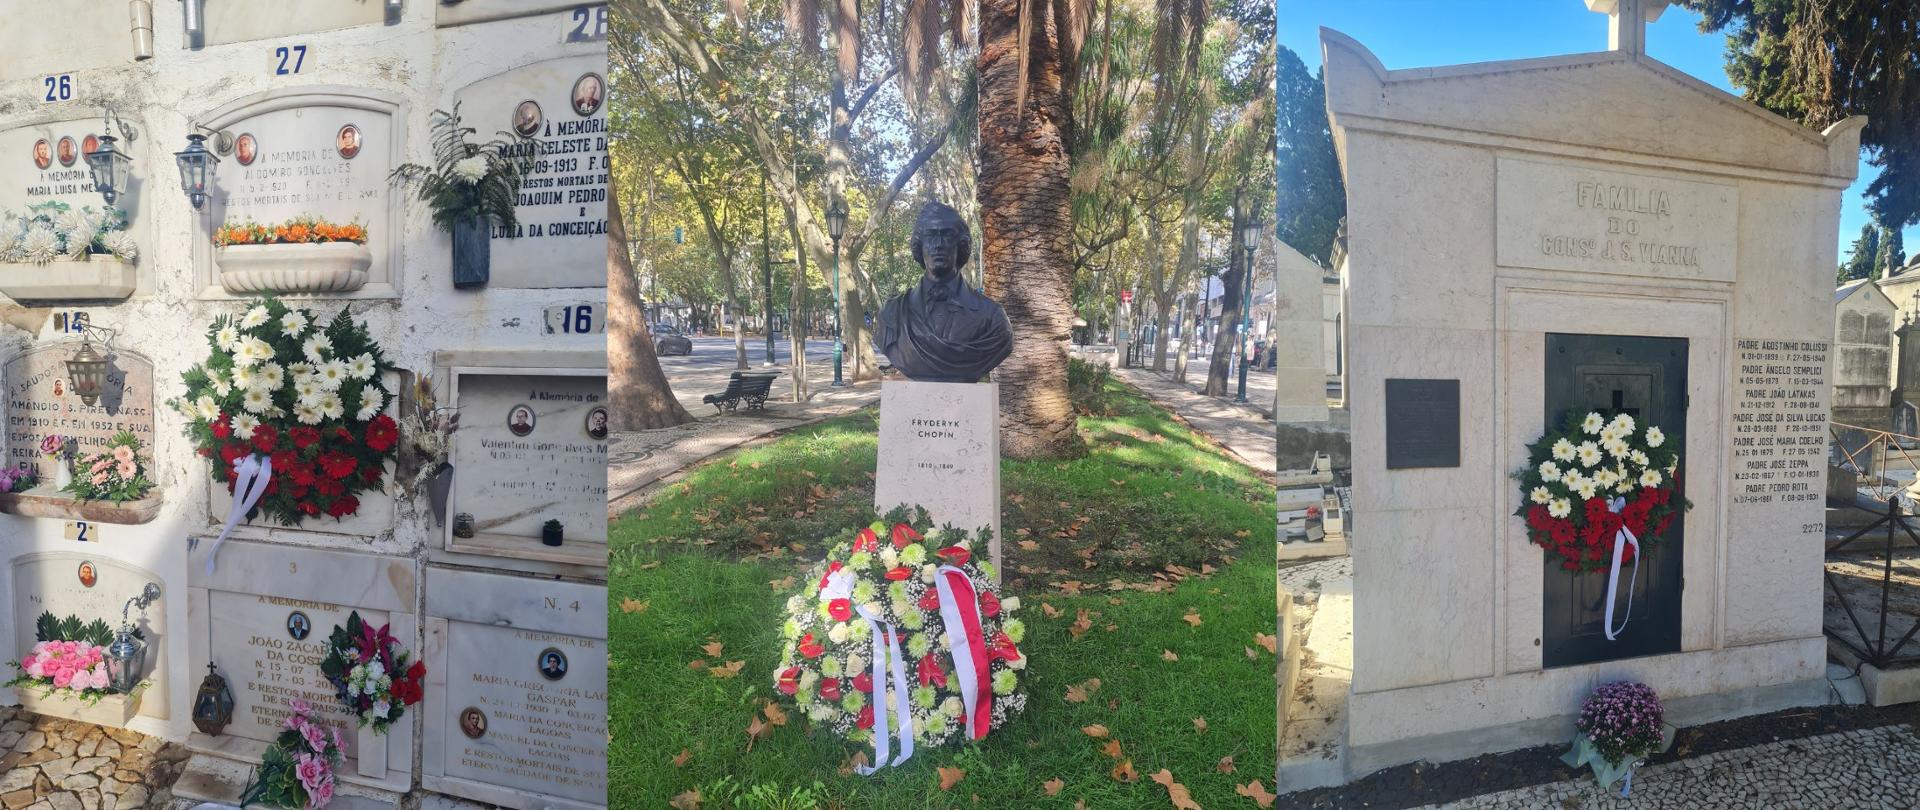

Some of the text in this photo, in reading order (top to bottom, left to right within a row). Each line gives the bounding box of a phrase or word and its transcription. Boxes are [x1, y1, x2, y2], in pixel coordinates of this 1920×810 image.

[275, 45, 307, 76] 27
[45, 75, 71, 102] 26
[557, 116, 608, 136] MEMÓRI
[498, 143, 535, 159] MARIA
[541, 138, 591, 155] CELESTE
[523, 178, 554, 189] RESTOS
[557, 175, 594, 187] MORTAIS
[27, 183, 95, 196] MARIA LUISA ME
[514, 188, 606, 207] JOAQUIM PEDRO
[579, 206, 586, 217] E
[529, 223, 543, 237] DA
[1608, 217, 1640, 235] DO
[1639, 242, 1699, 266] VIANNA
[562, 305, 593, 334] 16
[1737, 340, 1828, 352] PADRE AGOSTINHO COLUSSI
[1741, 365, 1763, 374] PADRE
[1793, 366, 1822, 375] SEMPLICI
[586, 393, 599, 402] de
[1745, 389, 1767, 399] PADRE
[1788, 390, 1816, 399] LATAKAS
[911, 418, 960, 428] FRYDERYK
[1733, 413, 1754, 423] PADRE
[1775, 413, 1785, 422] DA
[1786, 413, 1804, 422] SILVA
[1805, 413, 1826, 422] LUCAS
[10, 417, 25, 426] EM
[90, 421, 113, 431] 1952
[128, 424, 151, 433] SUA
[918, 431, 954, 439] CHOPIN
[1733, 434, 1824, 447] PADRE JOSÉ MARIA COELHO
[12, 448, 42, 459] REIRA
[1747, 460, 1768, 470] PADRE
[1789, 460, 1809, 469] ZEPPA
[1745, 482, 1809, 493] PADRE PEDRO ROTA
[76, 521, 88, 542] 2
[1802, 523, 1824, 534] 2272
[289, 562, 297, 575] 3
[544, 596, 581, 613] N. 4
[267, 649, 284, 662] DA
[472, 672, 511, 687] MARIA
[248, 681, 256, 691] E
[258, 683, 299, 698] RESTOS
[263, 694, 278, 704] DE
[527, 692, 577, 708] GASPAR
[257, 716, 272, 726] DE
[494, 710, 543, 725] MARIA DA
[528, 725, 572, 740] LAGOAS
[516, 757, 562, 774] MORTAIS
[564, 766, 580, 776] DE
[555, 774, 571, 785] DE
